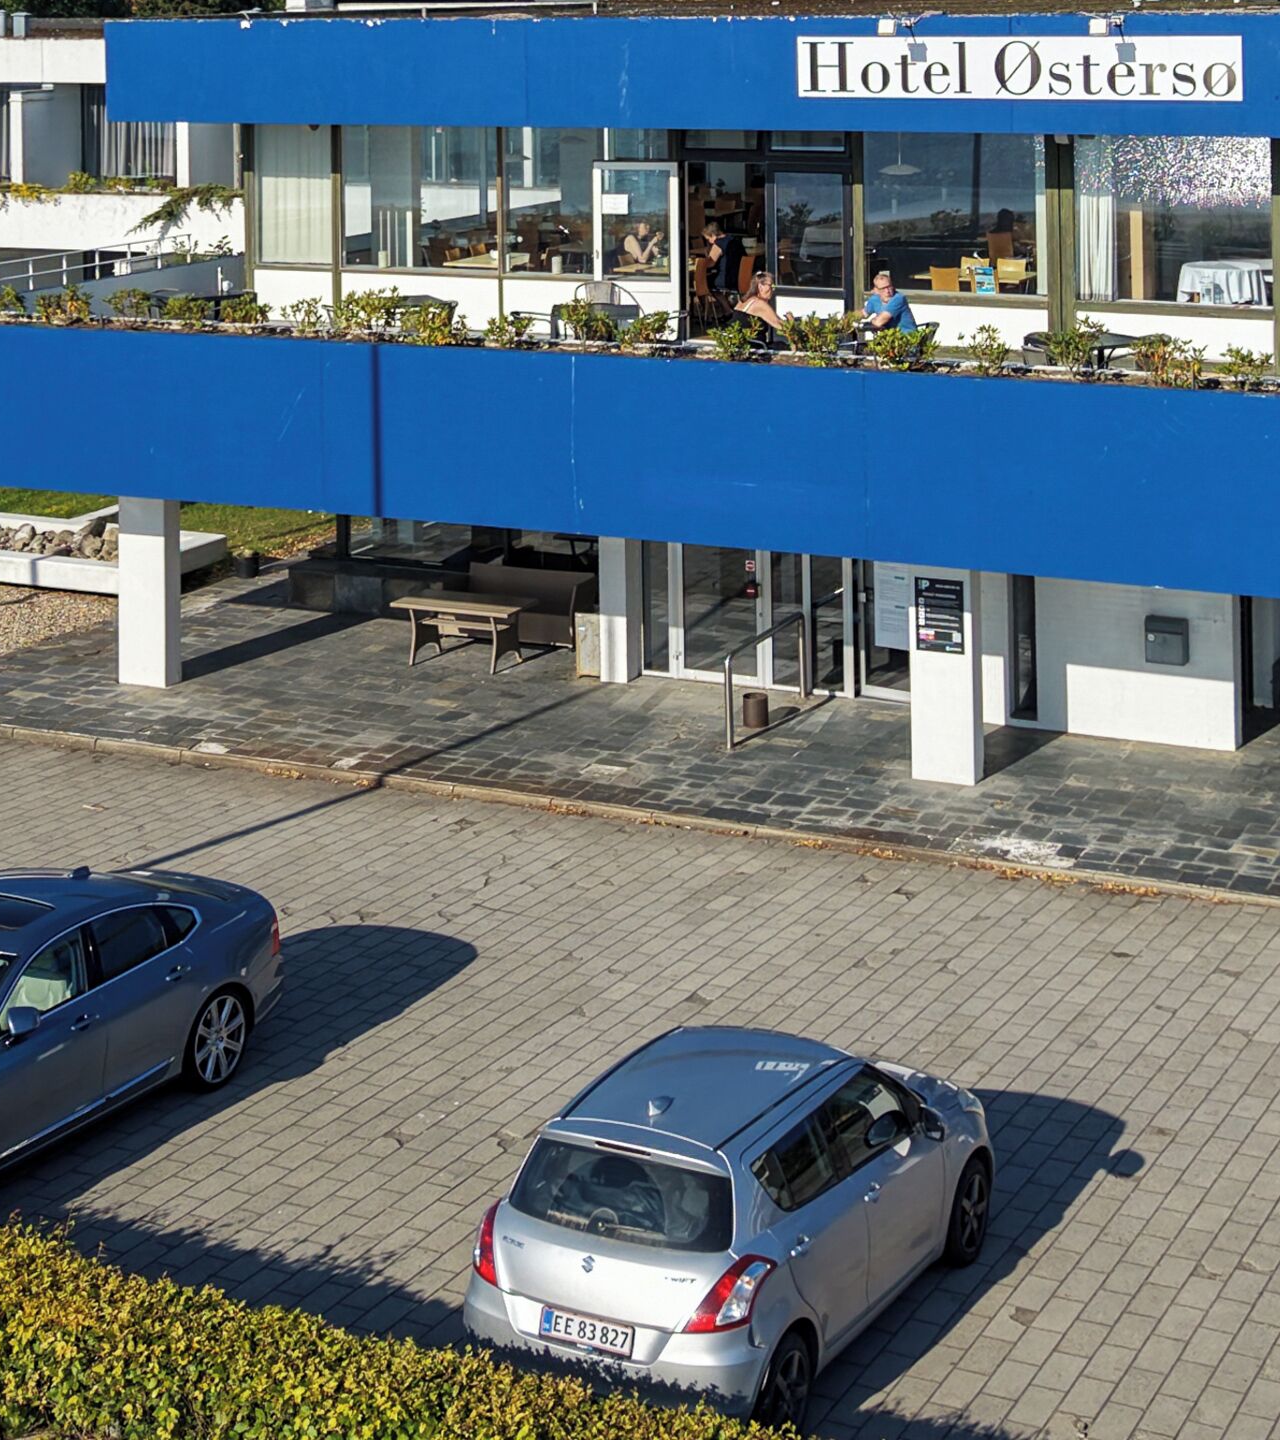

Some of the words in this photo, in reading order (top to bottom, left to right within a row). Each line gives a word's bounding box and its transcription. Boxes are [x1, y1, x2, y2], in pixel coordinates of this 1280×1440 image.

[802, 41, 973, 95] Hotel
[994, 40, 1238, 98] Østersø
[553, 1315, 574, 1336] EE
[577, 1320, 597, 1341] 83
[600, 1326, 629, 1349] 827
